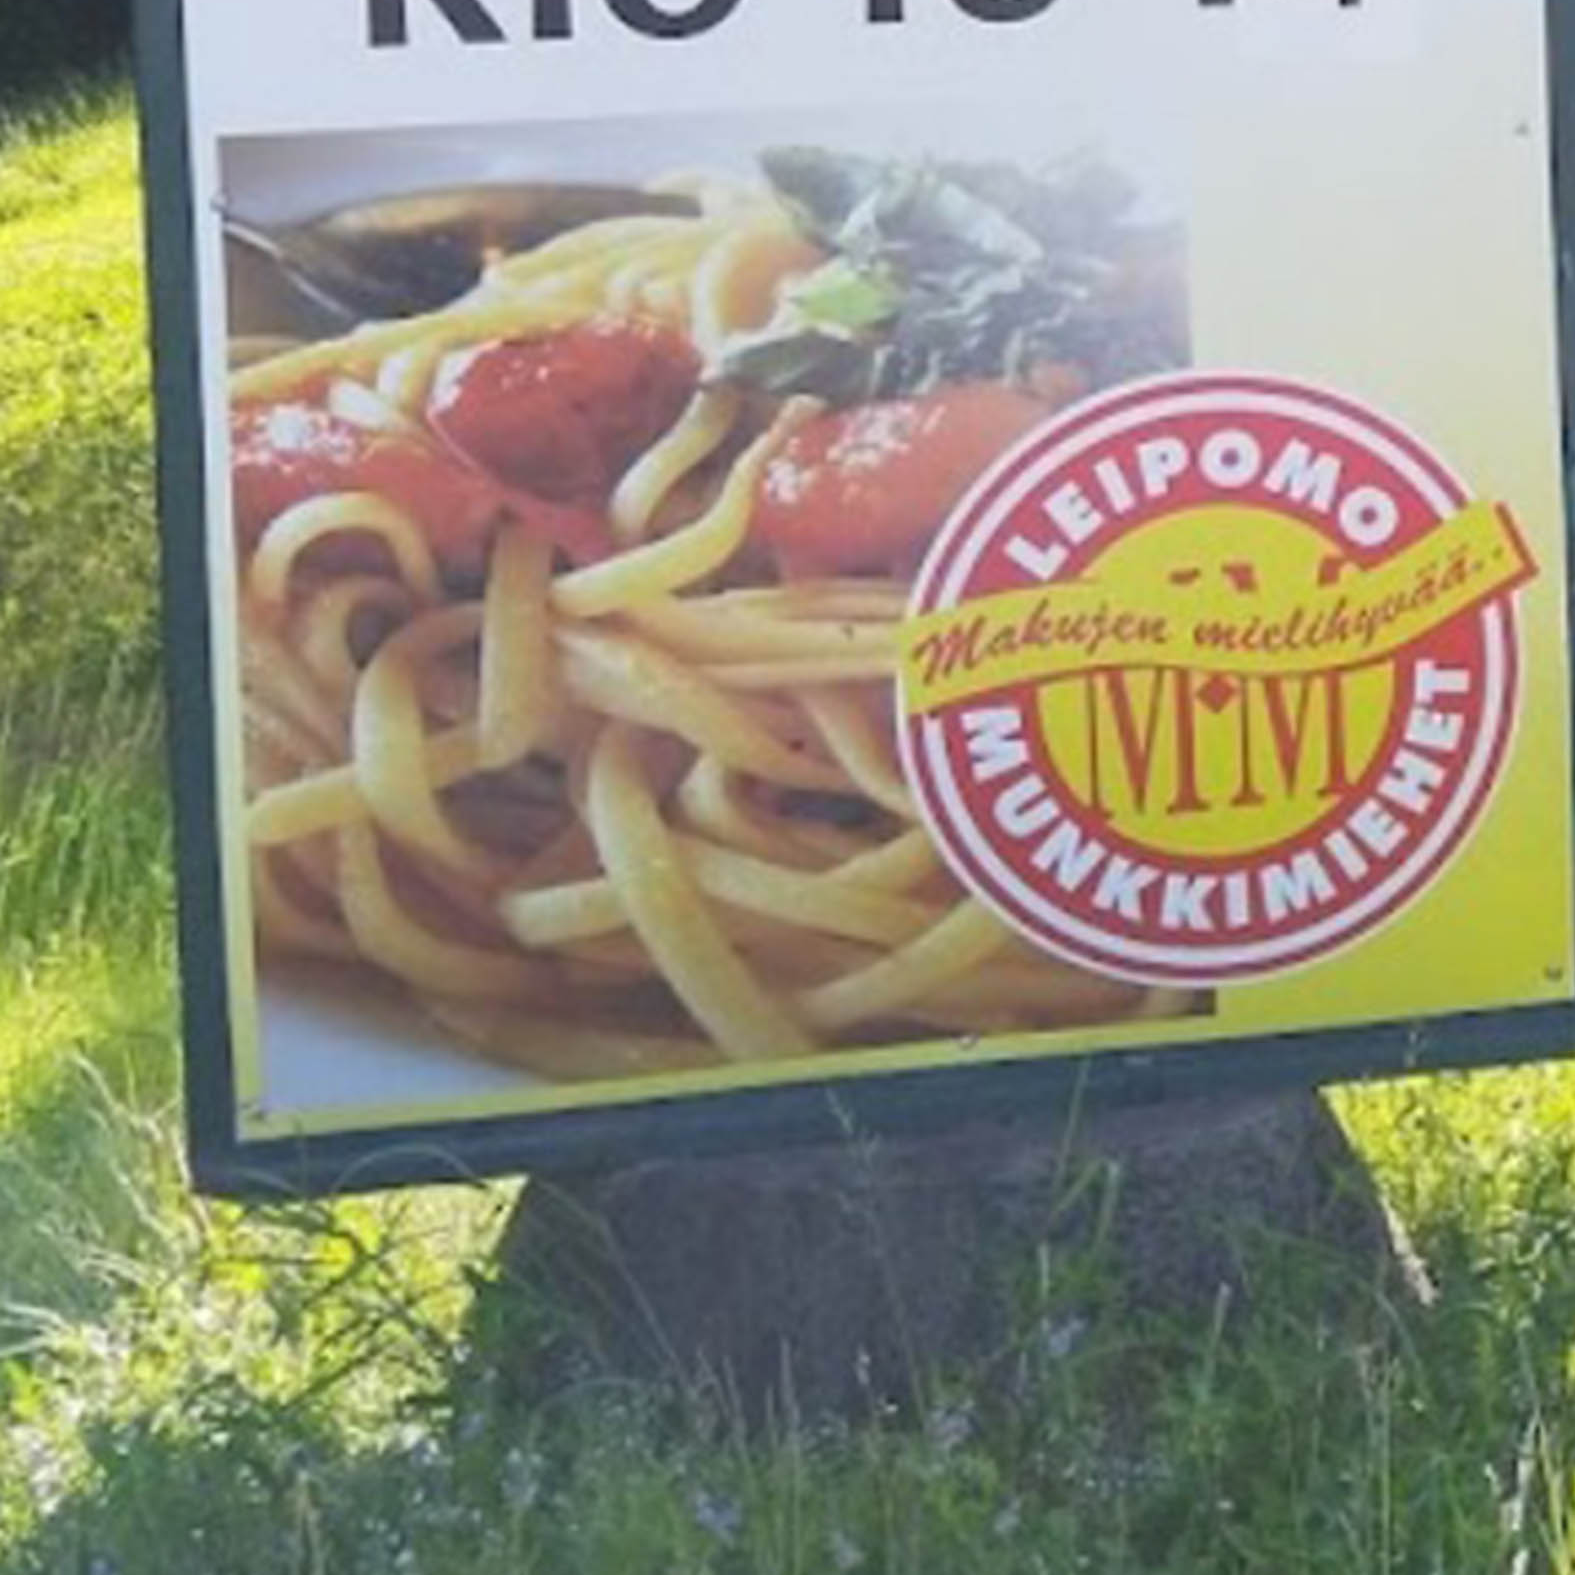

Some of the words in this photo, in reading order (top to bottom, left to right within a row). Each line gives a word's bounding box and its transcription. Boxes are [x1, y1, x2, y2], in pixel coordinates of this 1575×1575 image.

[1006, 429, 1400, 581] LEIPOMO
[912, 599, 1170, 686] Makujen
[961, 659, 1471, 933] MUNKKIMIEHET
